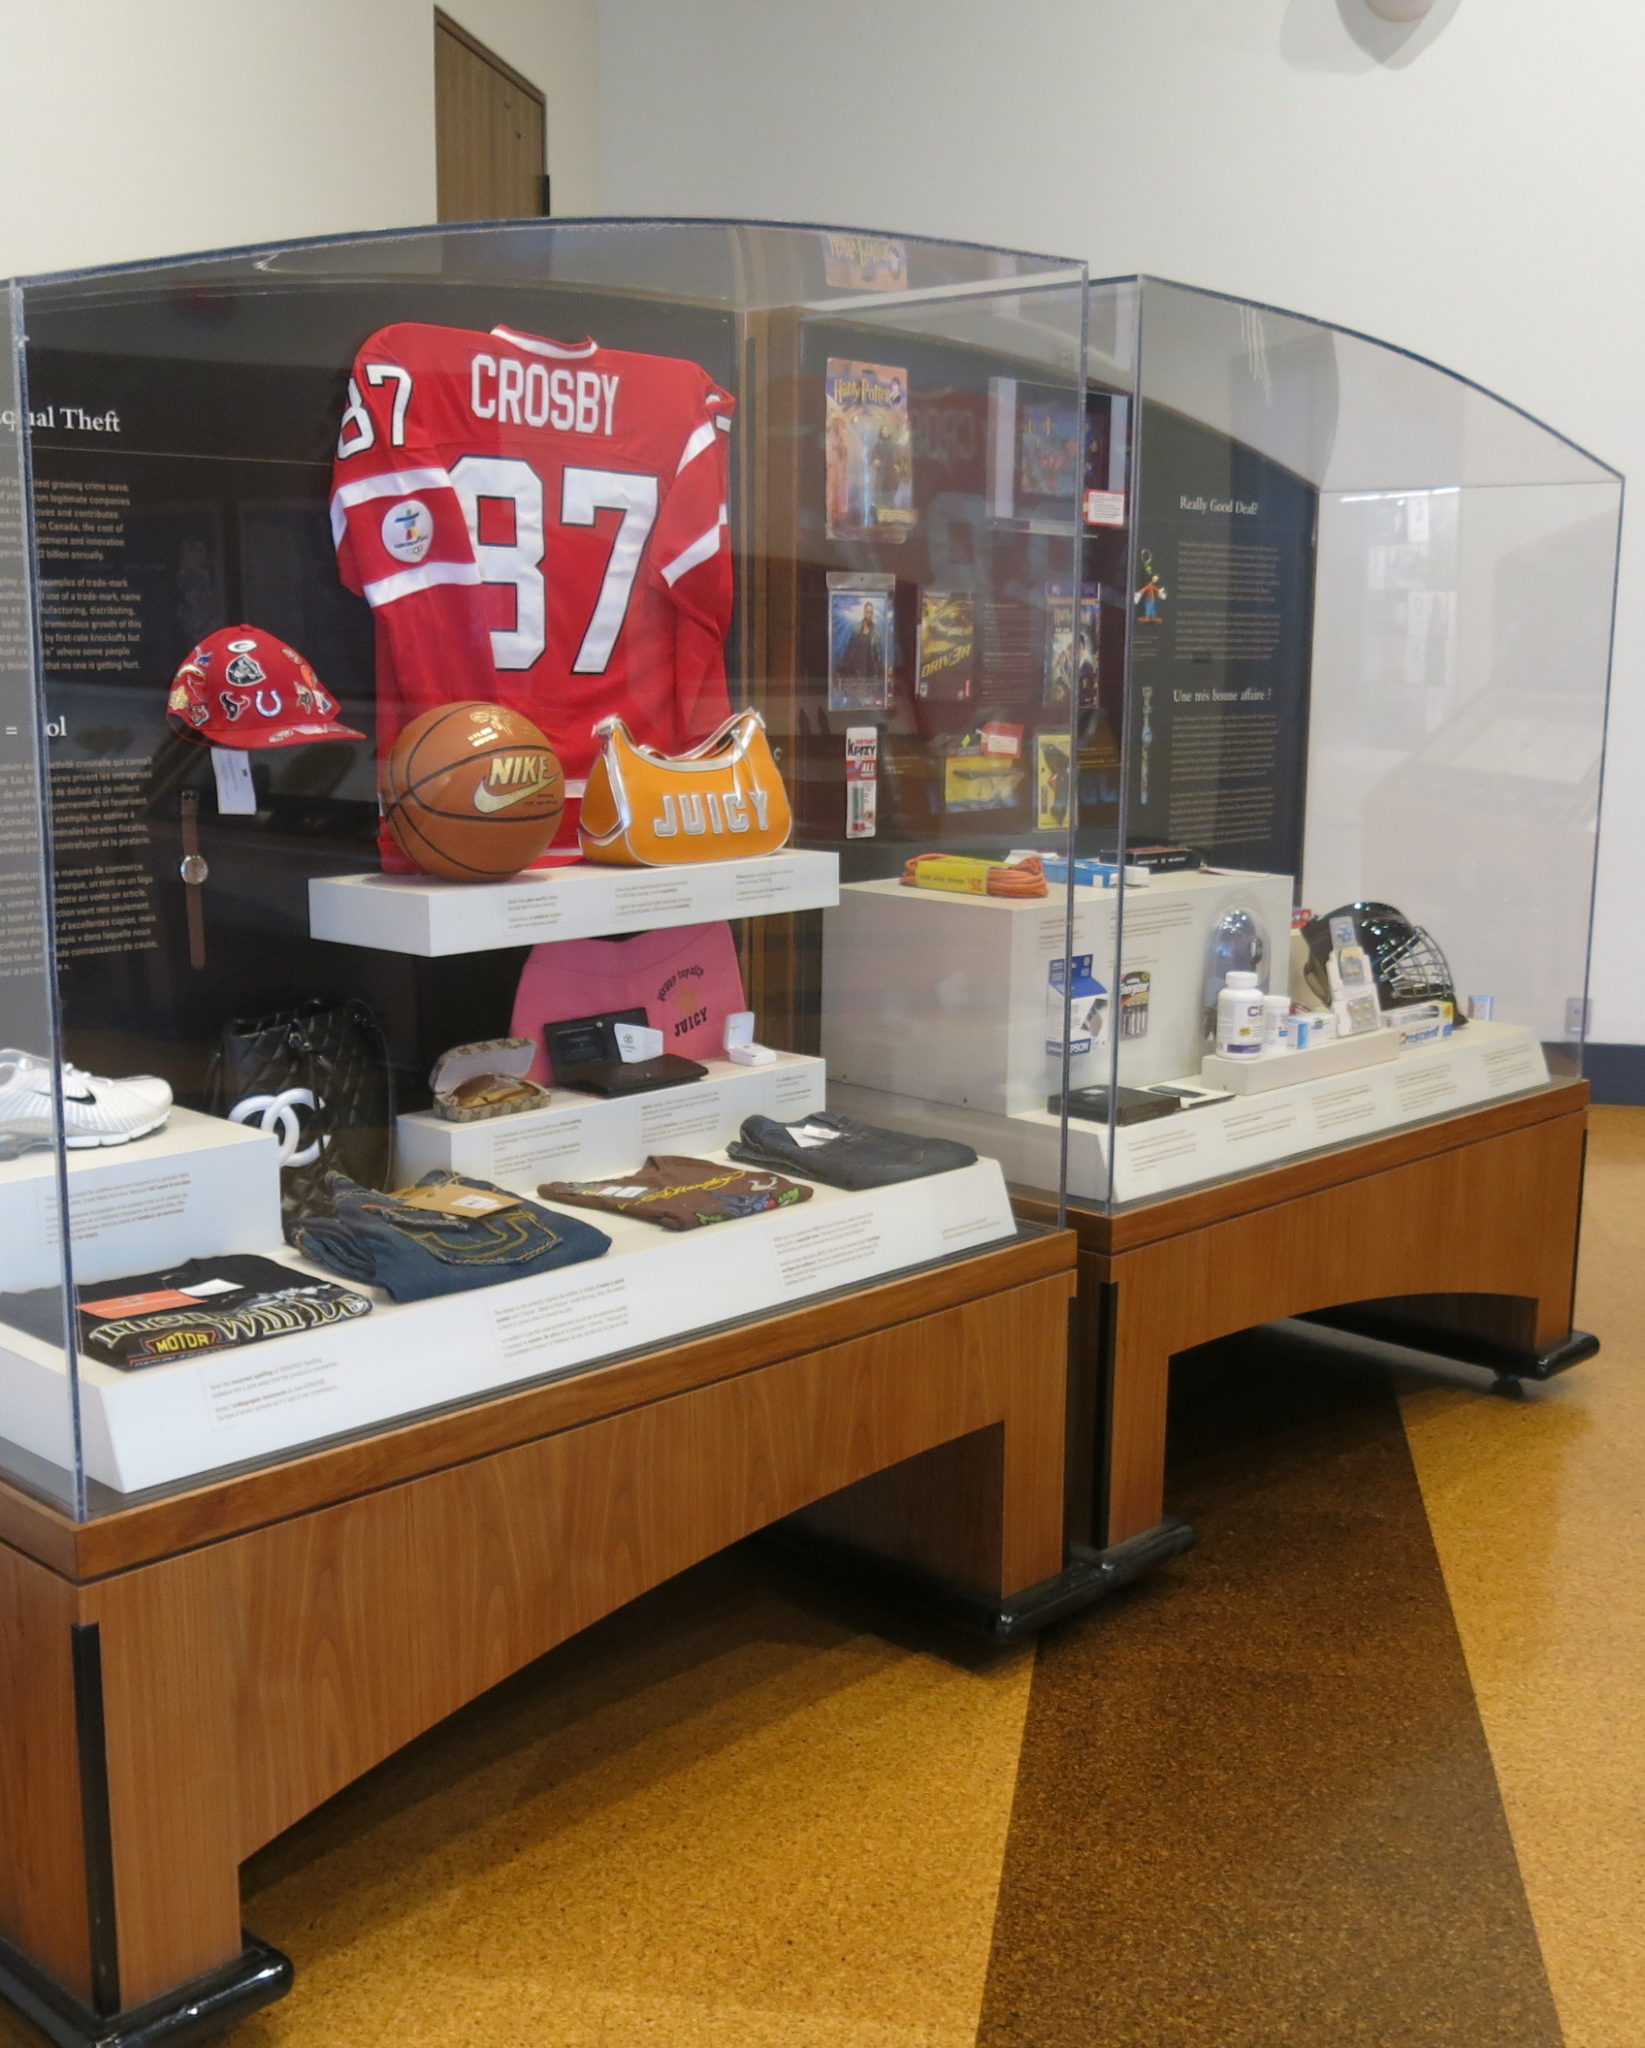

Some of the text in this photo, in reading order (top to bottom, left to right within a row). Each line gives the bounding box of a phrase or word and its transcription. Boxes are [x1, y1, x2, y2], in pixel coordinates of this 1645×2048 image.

[471, 354, 619, 436] CROSBY
[60, 408, 120, 432] Theft
[336, 363, 413, 460] 87
[1210, 499, 1233, 513] Good
[447, 454, 659, 675] 87
[46, 715, 67, 737] ol
[488, 756, 548, 786] NIKE
[653, 790, 768, 837] JUICY
[674, 1006, 708, 1038] JUICY
[156, 1332, 210, 1354] MOTOR
